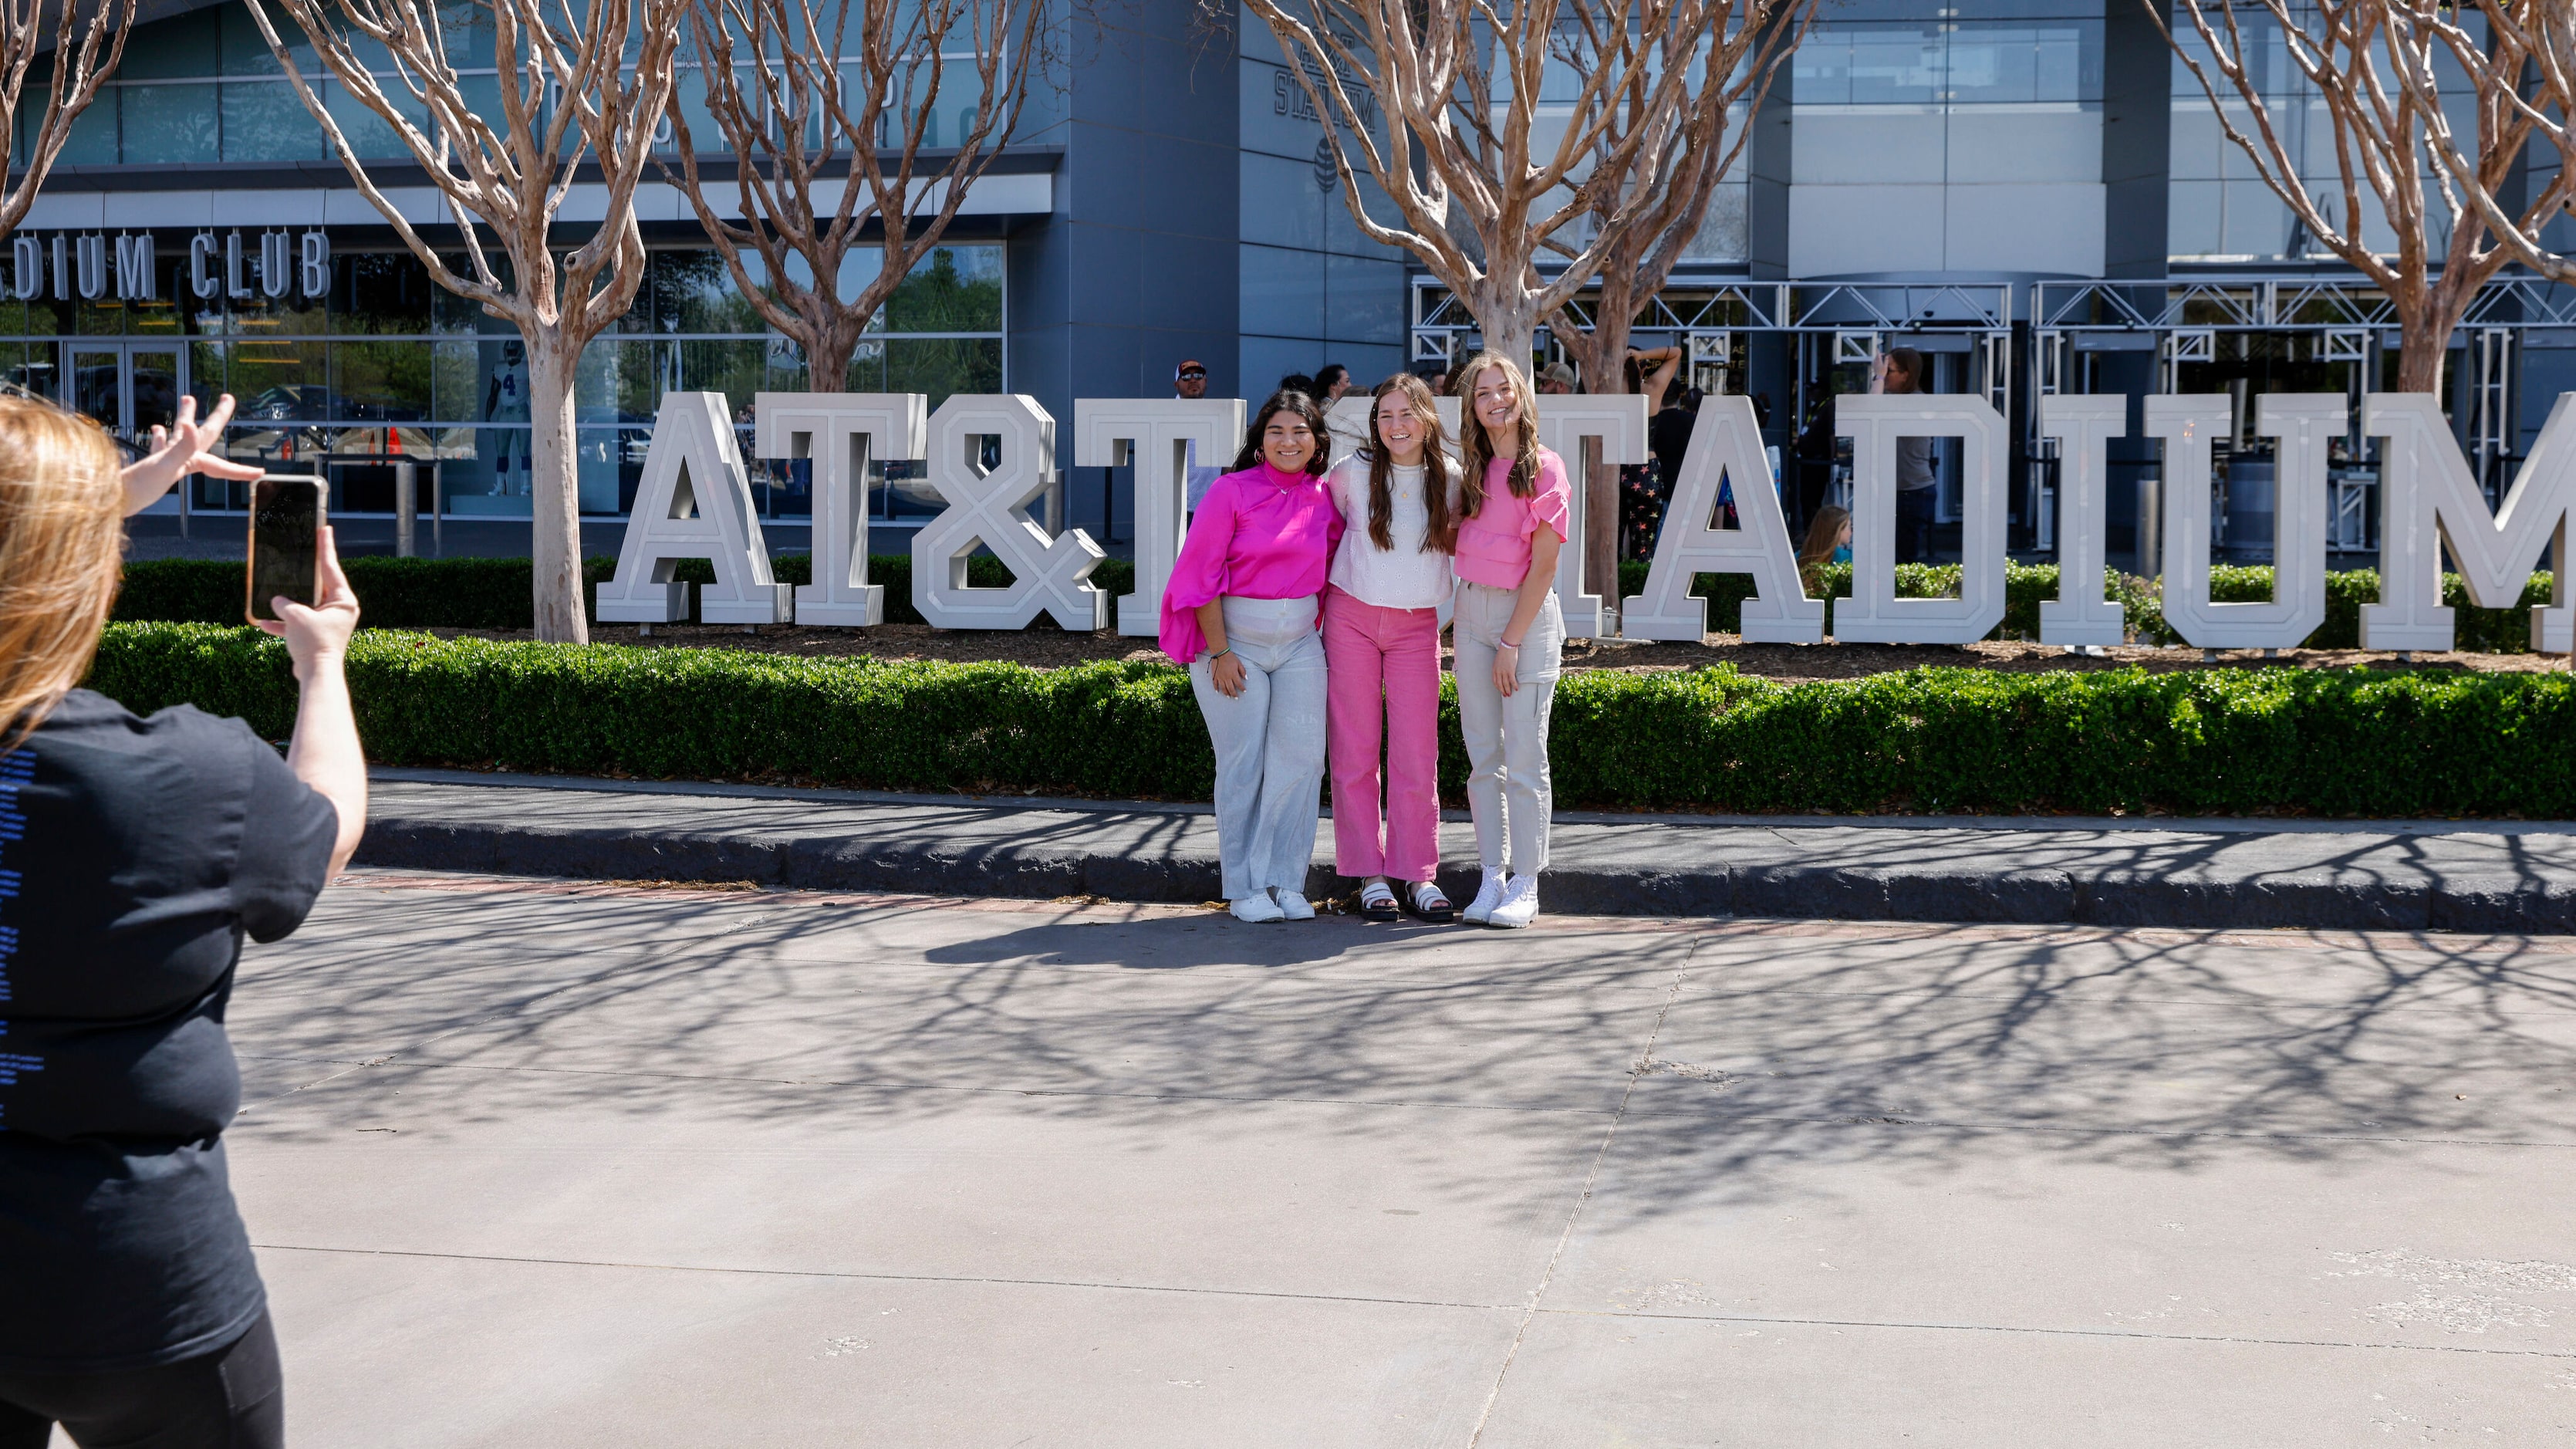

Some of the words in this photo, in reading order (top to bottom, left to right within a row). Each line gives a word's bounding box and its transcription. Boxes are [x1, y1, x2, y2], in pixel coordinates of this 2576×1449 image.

[0, 235, 157, 301] DIUM
[191, 232, 332, 299] CLUB
[503, 373, 516, 396] 4
[596, 390, 1247, 637] AT&T
[1323, 390, 2576, 652] TADIUM
